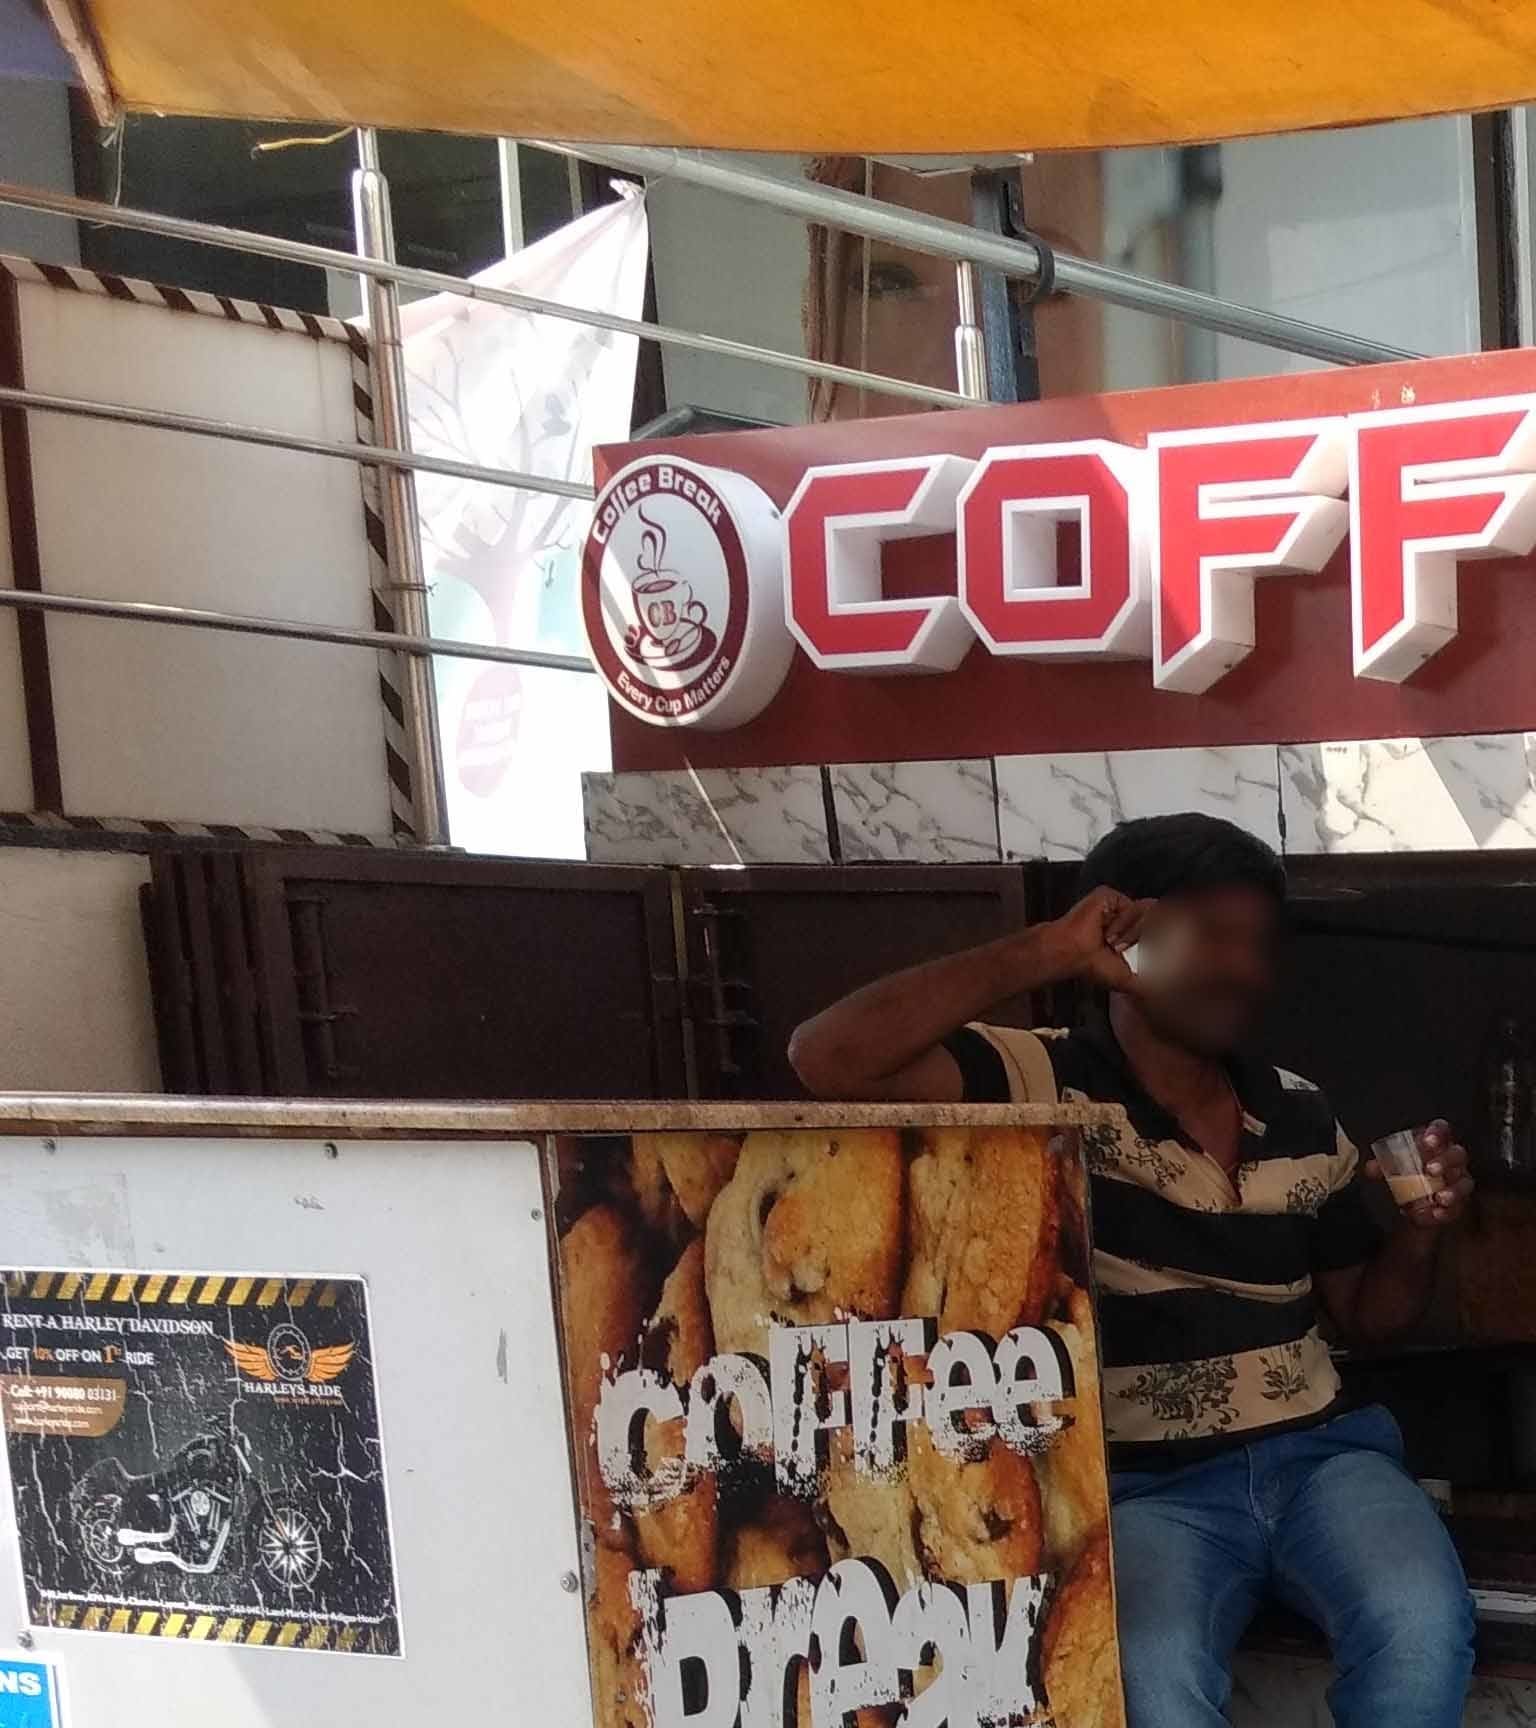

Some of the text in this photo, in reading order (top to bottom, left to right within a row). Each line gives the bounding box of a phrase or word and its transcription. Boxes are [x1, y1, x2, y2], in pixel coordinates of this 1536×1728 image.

[592, 466, 722, 543] Coffee Break
[649, 601, 676, 628] CB
[617, 656, 730, 716] Every Cup Matters
[62, 1316, 124, 1333] HARLEY
[129, 1320, 213, 1335] DAVIDSON
[56, 1349, 79, 1362] OFF
[82, 1351, 102, 1362] ON
[125, 1352, 154, 1365] RIDE
